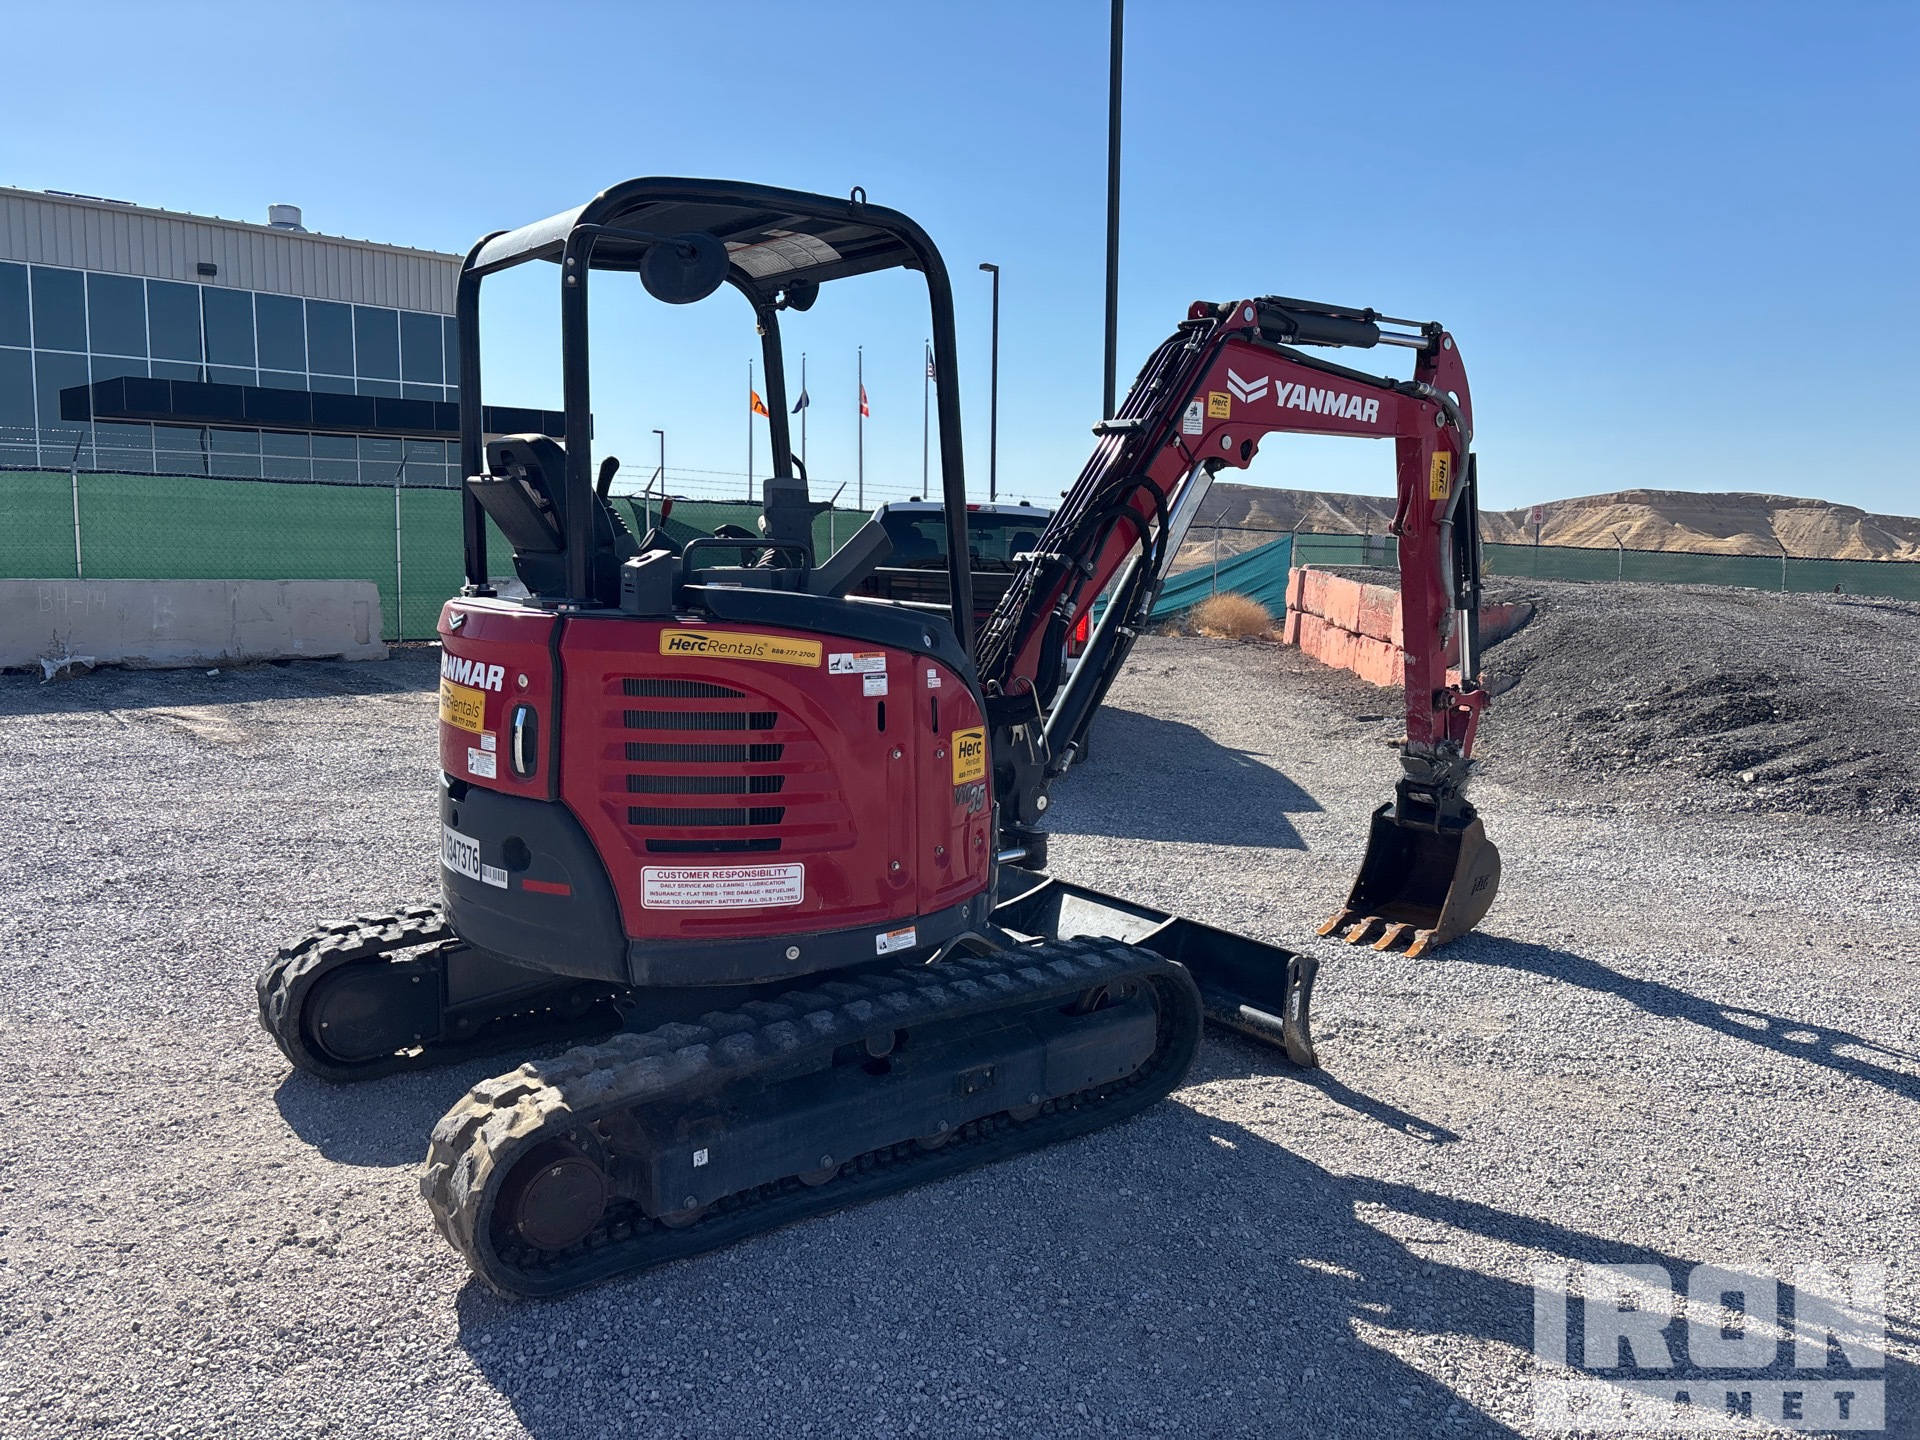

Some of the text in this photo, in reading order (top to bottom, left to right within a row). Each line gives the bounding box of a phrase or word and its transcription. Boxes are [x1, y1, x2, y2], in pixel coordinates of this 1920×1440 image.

[1212, 396, 1229, 407] Herc
[1274, 380, 1380, 424] YANMAR
[1439, 459, 1447, 493] Herc
[771, 647, 816, 659] 888-777-2700
[958, 741, 982, 758] Herc
[657, 868, 788, 879] CUSTOMER RESPONSIBILITY
